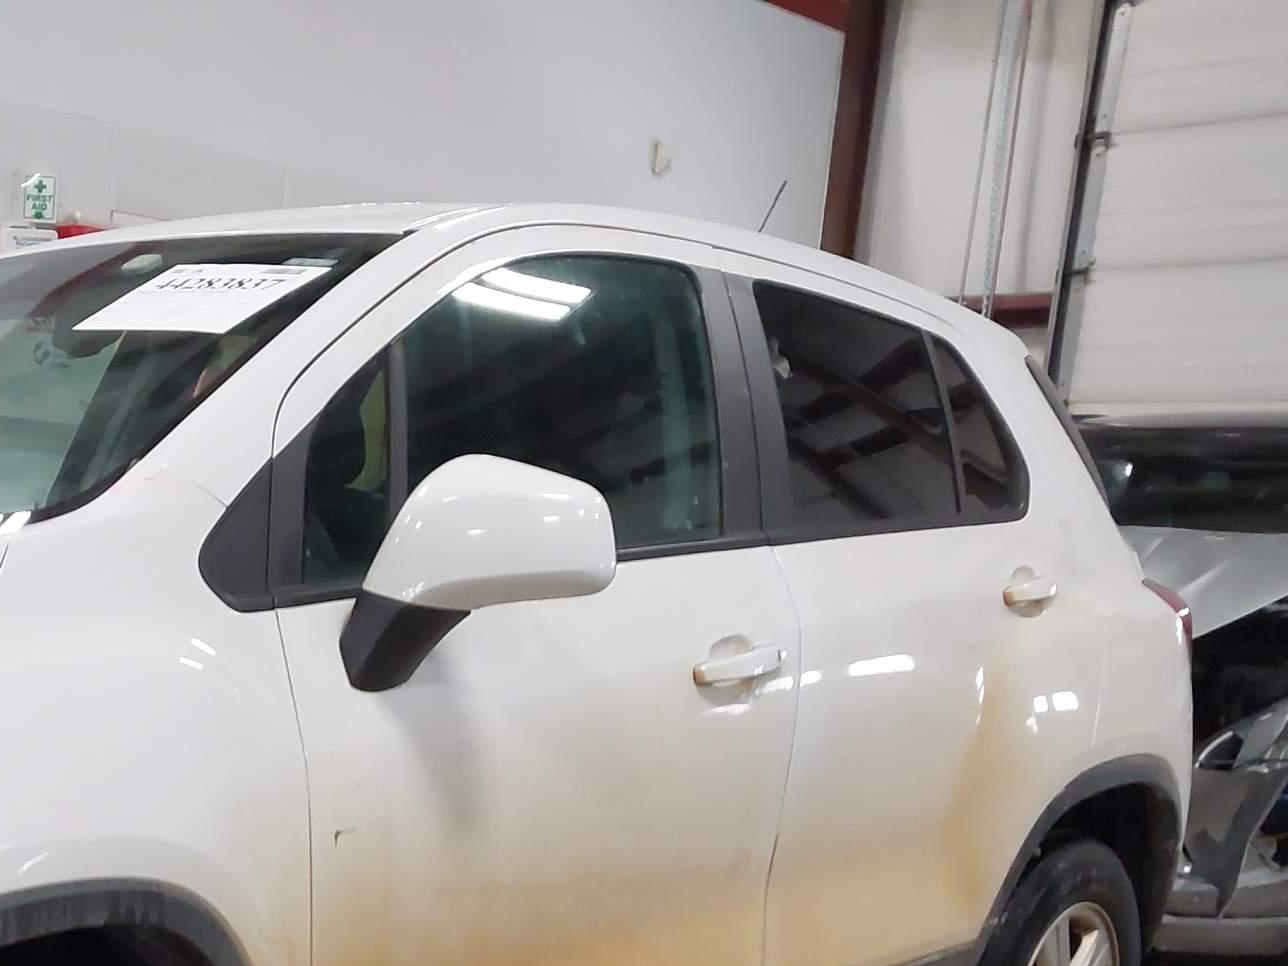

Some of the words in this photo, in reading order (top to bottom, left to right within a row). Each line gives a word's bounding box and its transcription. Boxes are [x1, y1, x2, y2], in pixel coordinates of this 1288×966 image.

[26, 194, 54, 203] FIRST
[31, 203, 47, 212] AID
[155, 278, 288, 290] 44283837
